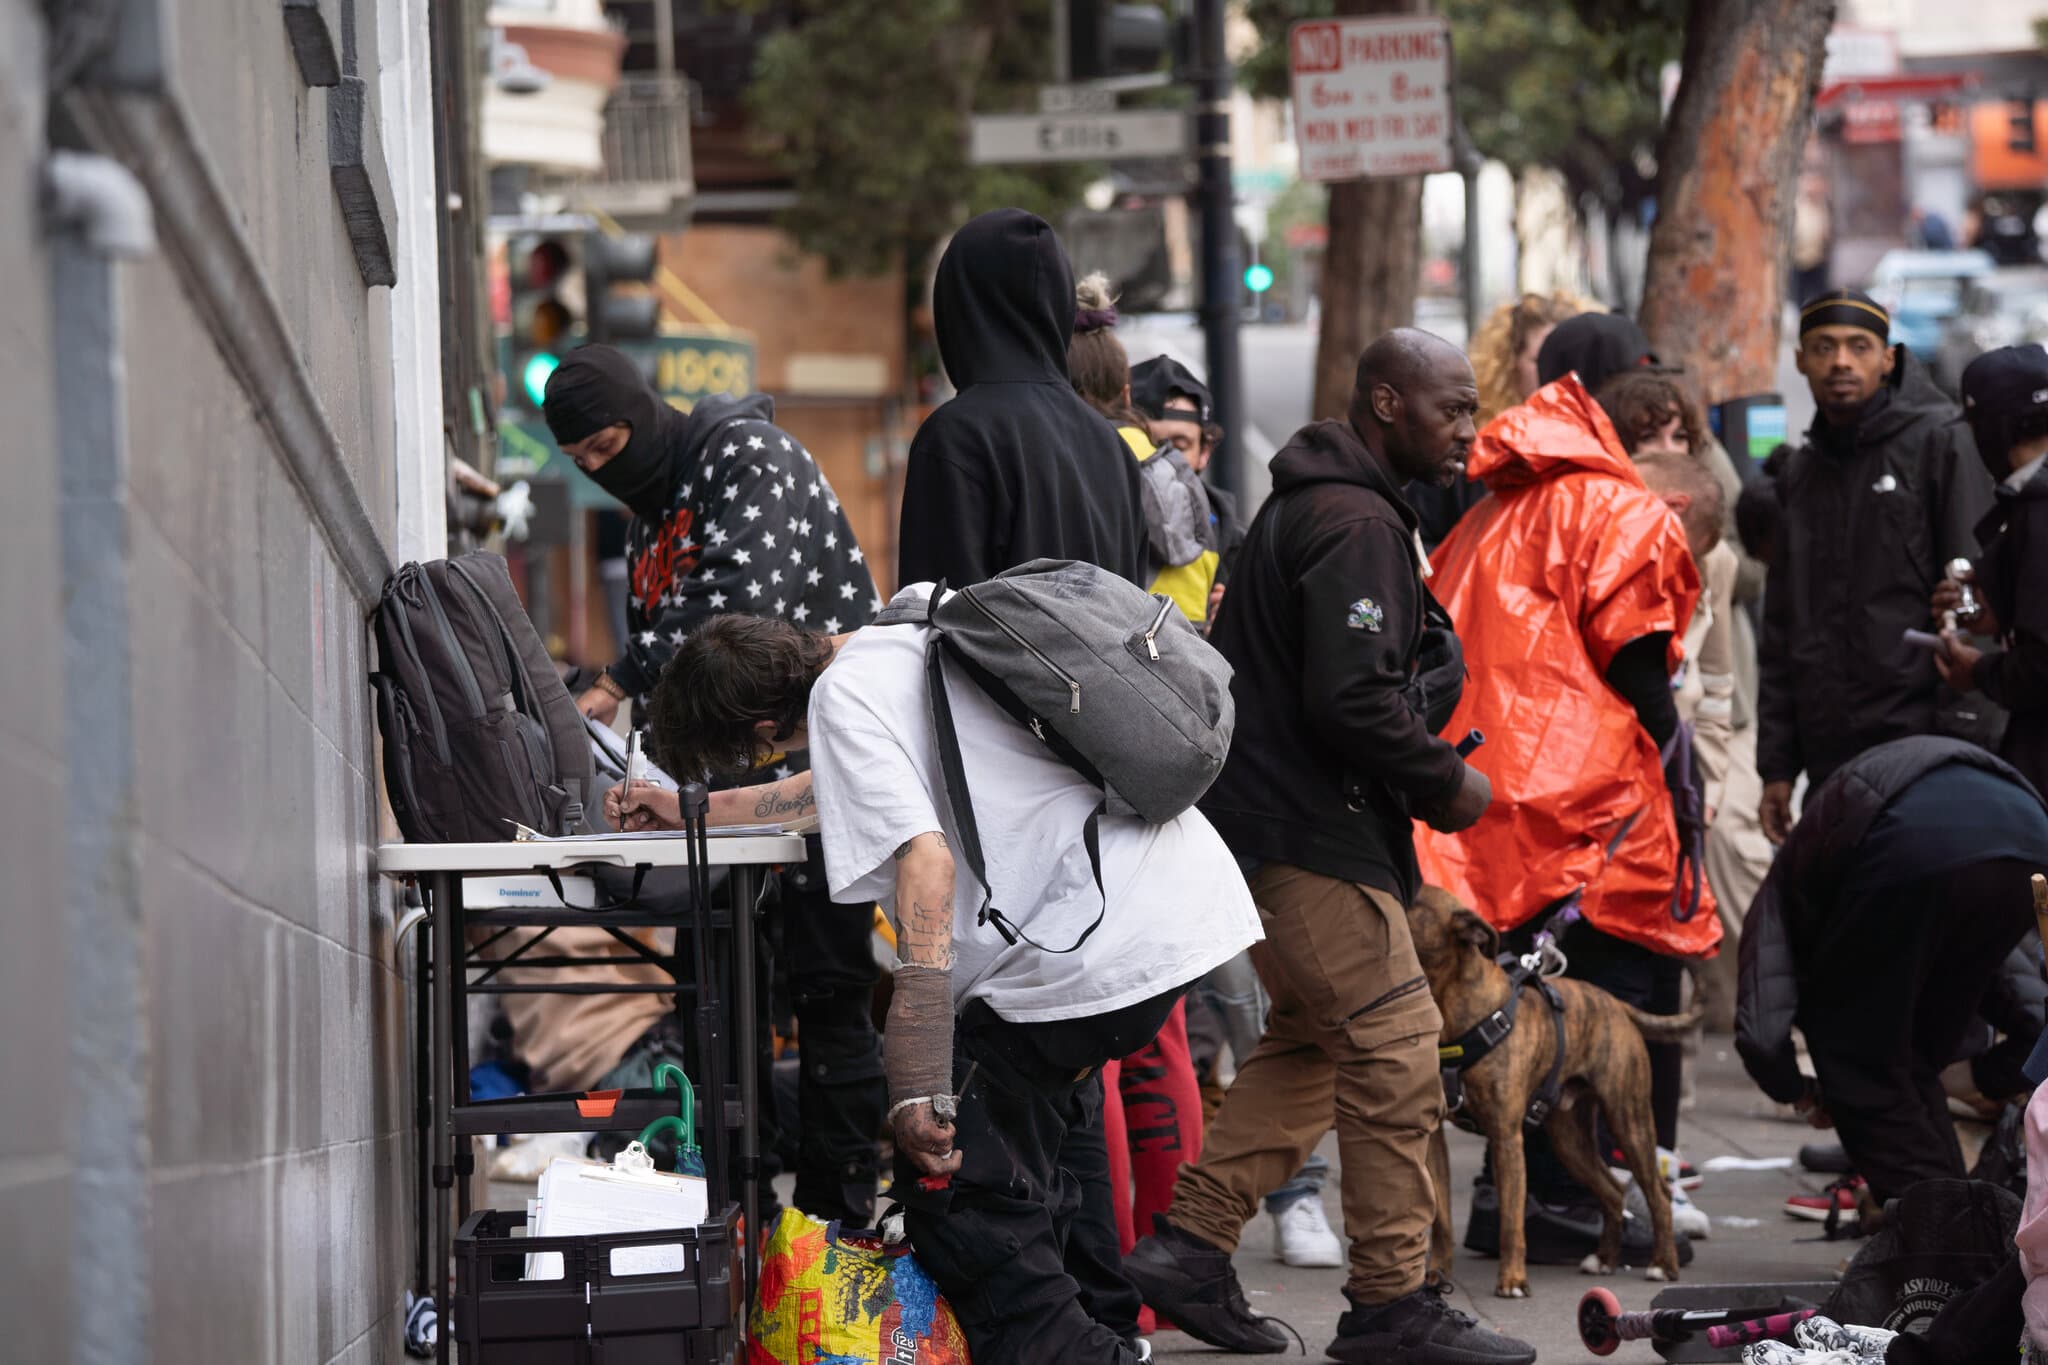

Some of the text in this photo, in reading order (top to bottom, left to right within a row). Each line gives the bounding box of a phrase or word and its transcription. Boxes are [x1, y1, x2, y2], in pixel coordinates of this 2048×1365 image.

[1299, 29, 1440, 67] NO PARKING
[1903, 1278, 1951, 1296] ASV2023
[895, 1334, 915, 1349] 128
